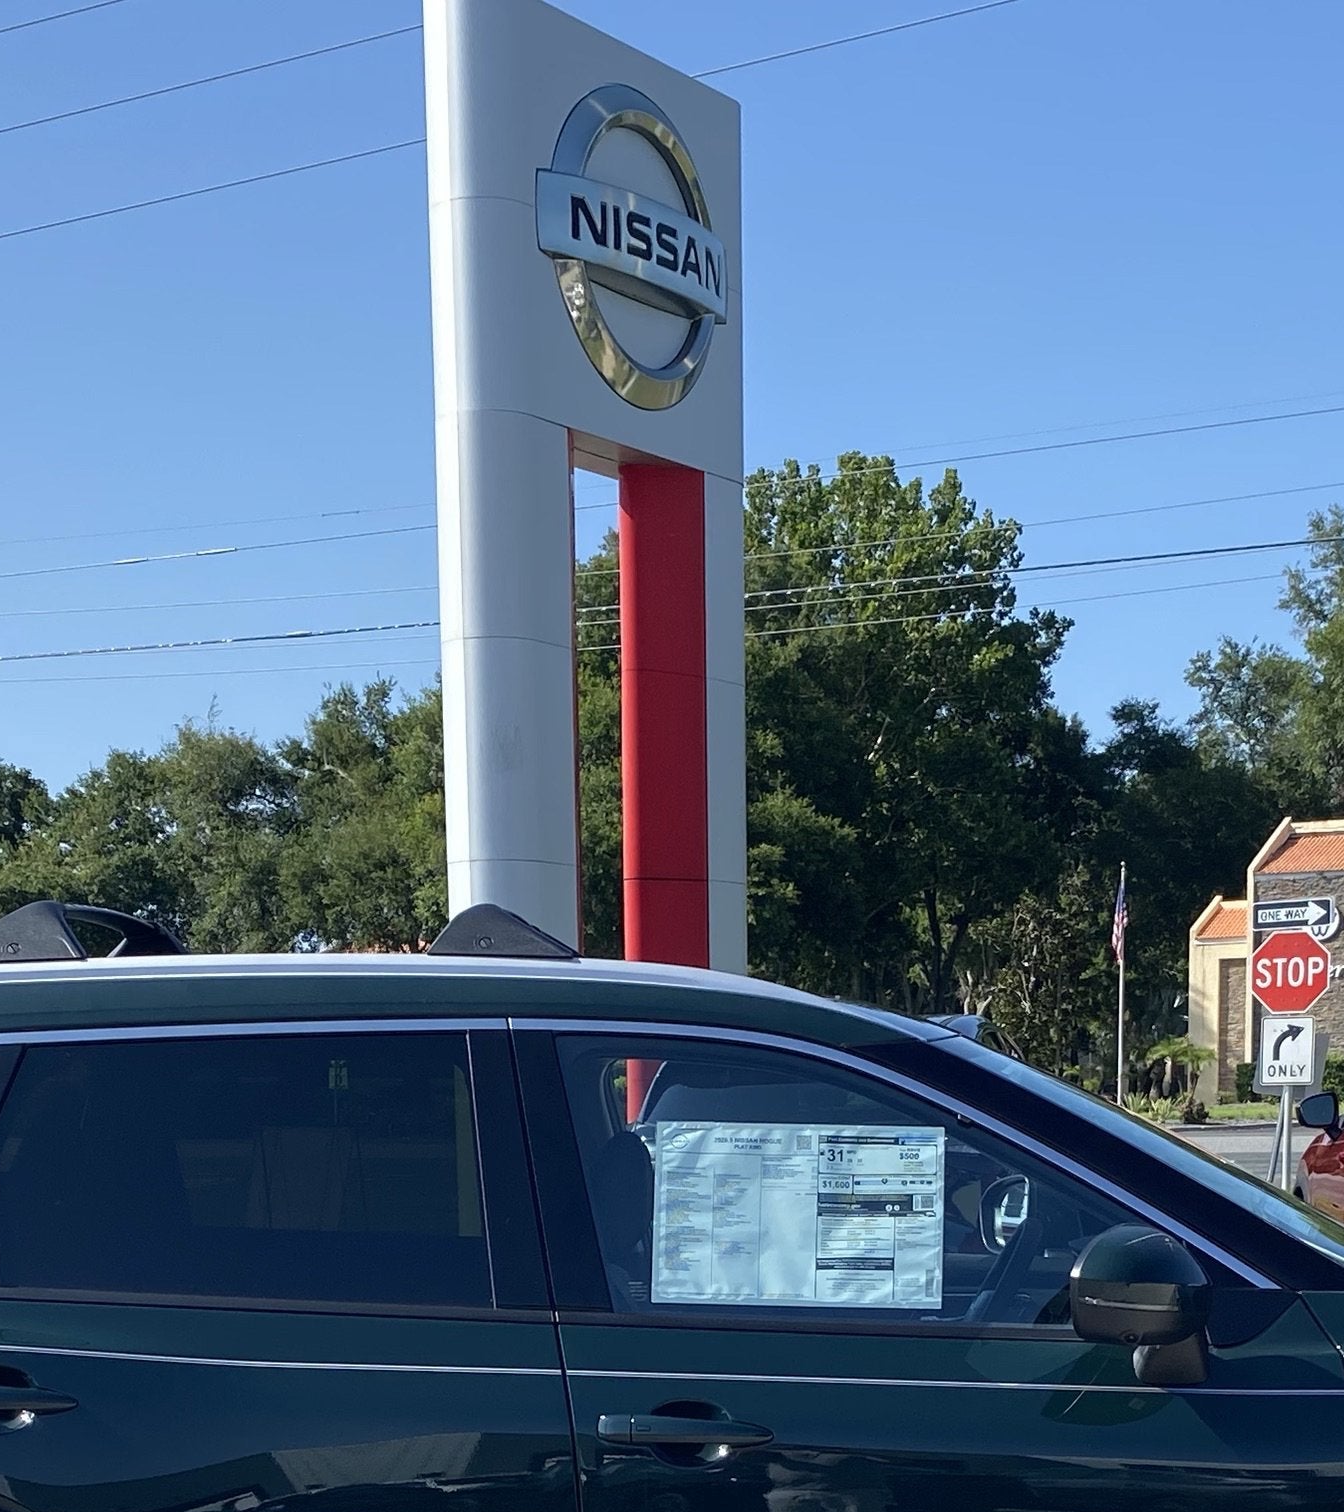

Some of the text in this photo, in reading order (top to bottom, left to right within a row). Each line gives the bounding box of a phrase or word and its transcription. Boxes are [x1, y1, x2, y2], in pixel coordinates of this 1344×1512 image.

[570, 194, 722, 298] NISSAN
[1260, 908, 1308, 922] ONE WAY
[1255, 956, 1325, 989] STOP
[1267, 1064, 1306, 1078] ONLY
[827, 1148, 844, 1162] 31
[899, 1152, 920, 1161] $500
